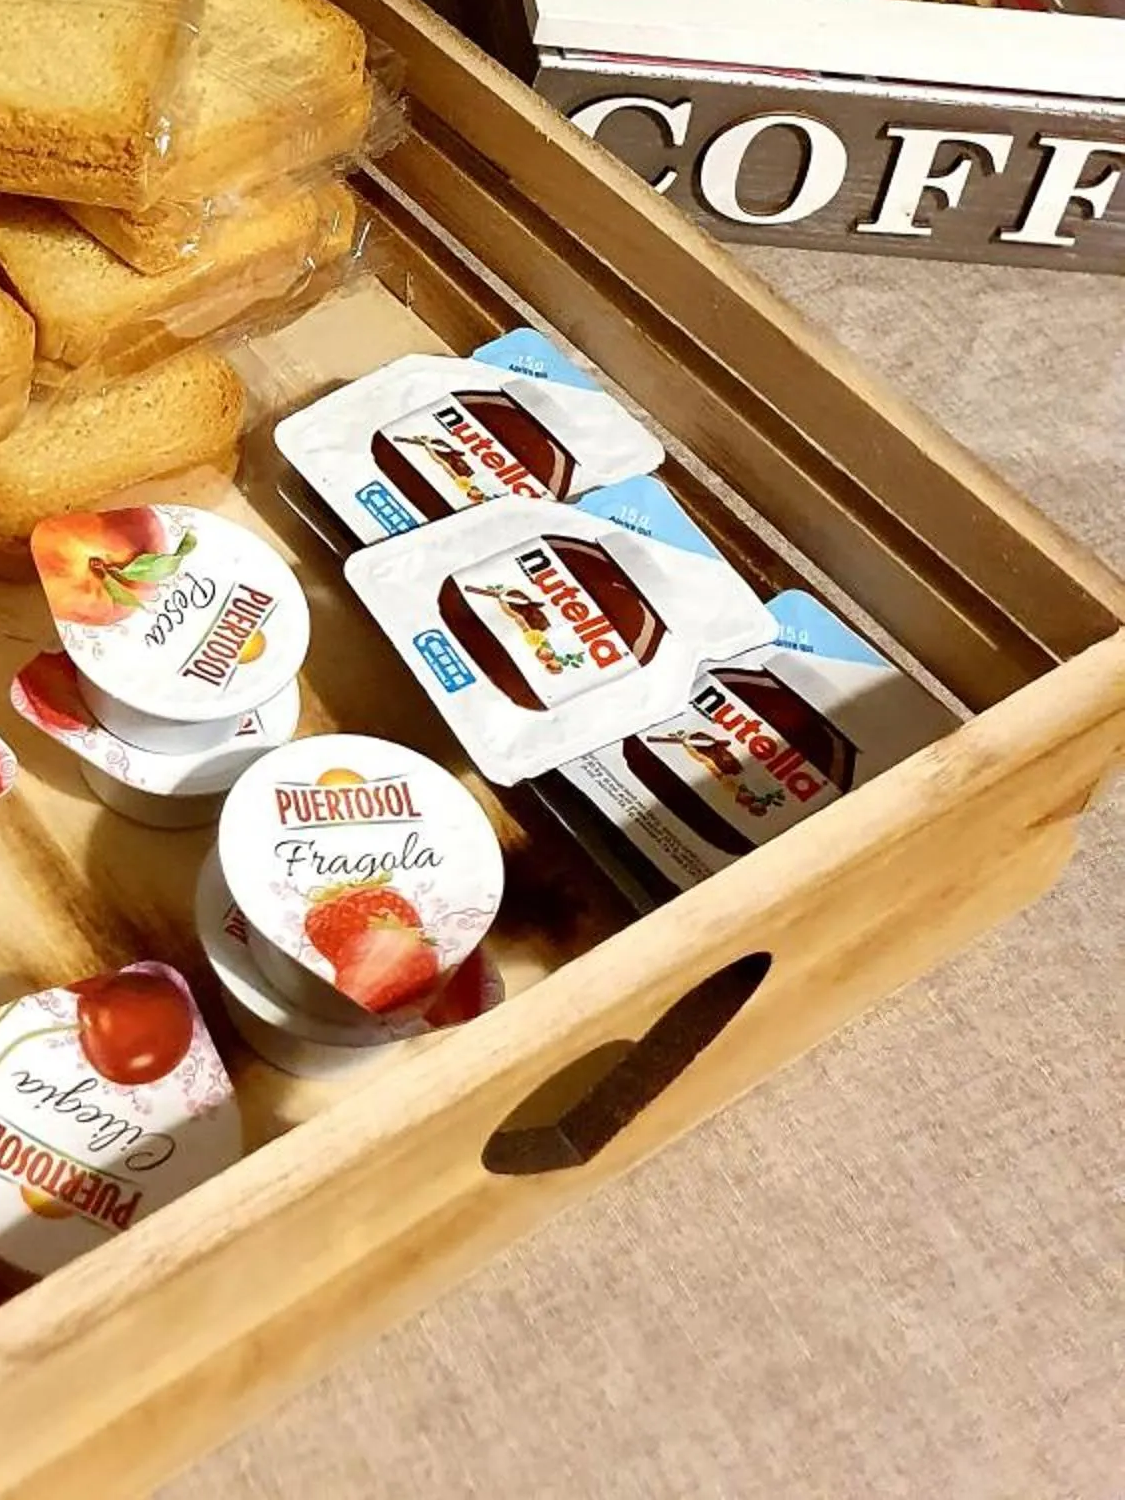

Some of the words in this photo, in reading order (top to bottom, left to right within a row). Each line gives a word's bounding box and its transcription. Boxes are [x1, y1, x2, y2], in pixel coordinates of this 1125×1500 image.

[570, 97, 1125, 247] COFF
[436, 406, 543, 499] nutella
[144, 571, 217, 648] Pesca
[181, 583, 274, 687] PUERTOSOL
[519, 547, 623, 669] nutella
[693, 685, 824, 804] nutella
[275, 781, 422, 825] PUERTOSOL
[274, 831, 444, 882] Fragola
[11, 1069, 176, 1172] Ciliegia
